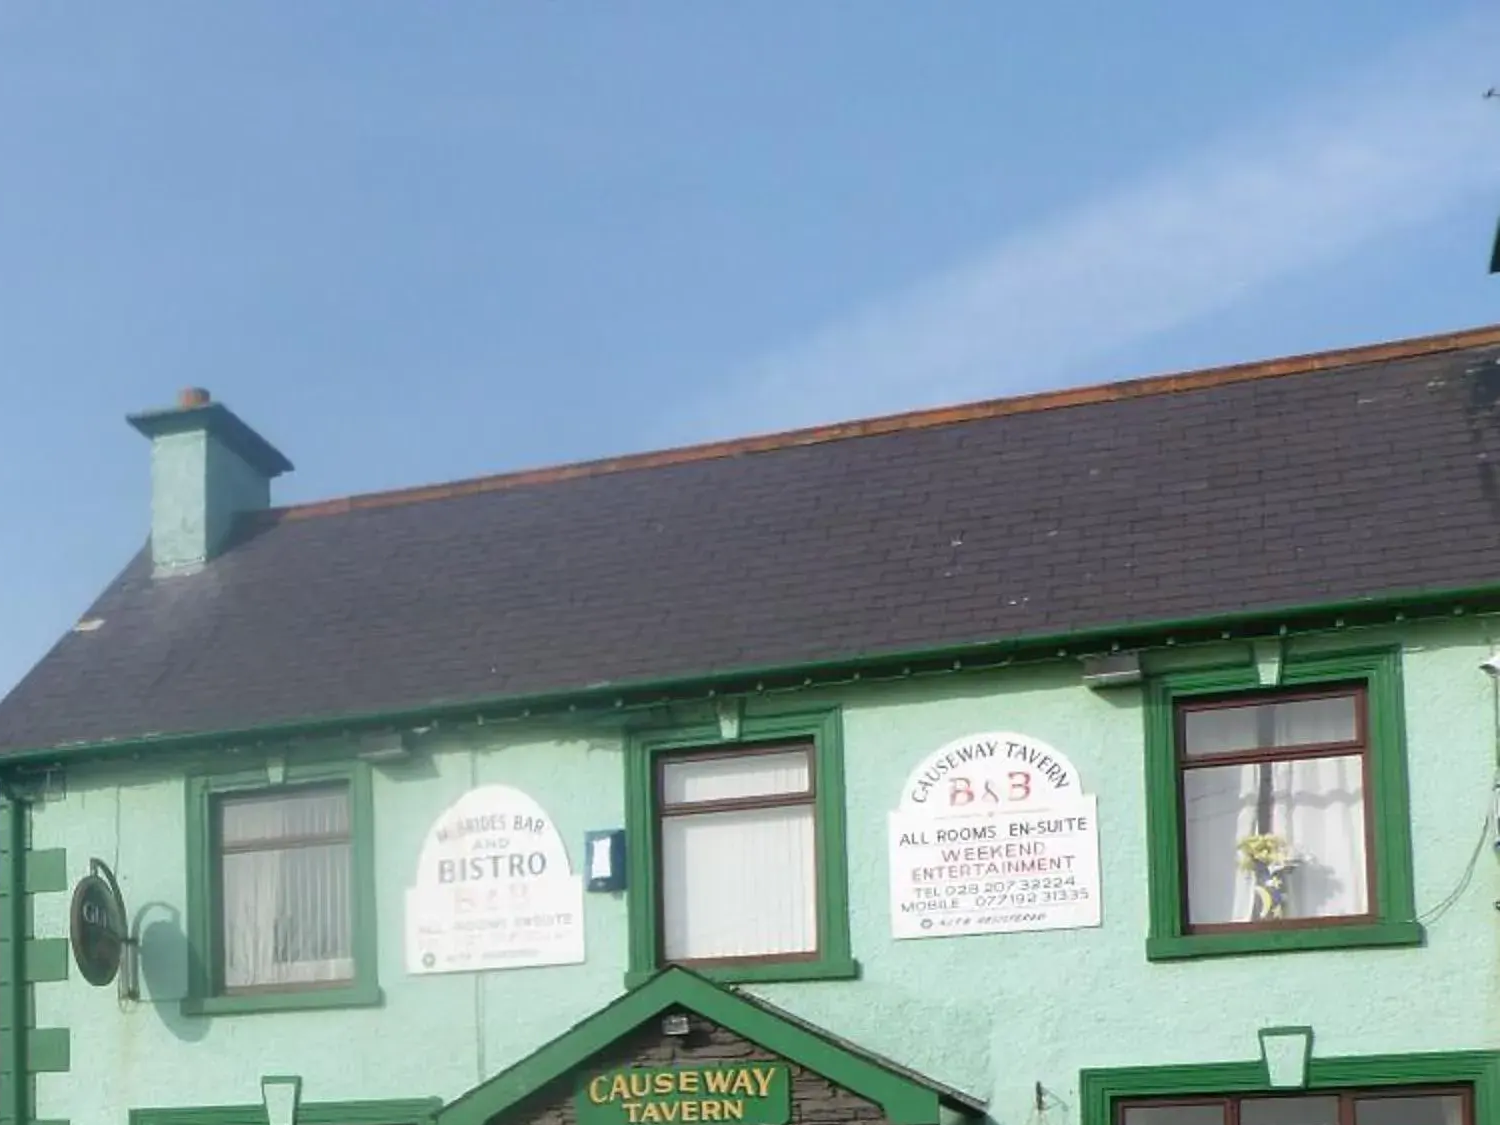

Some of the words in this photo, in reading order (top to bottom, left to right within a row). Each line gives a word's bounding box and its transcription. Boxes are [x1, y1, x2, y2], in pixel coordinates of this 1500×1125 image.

[912, 740, 998, 803] CAUSEWAY
[1006, 741, 1070, 790] TAVERN
[949, 777, 975, 806] B
[1008, 771, 1031, 801] B
[513, 815, 545, 835] BAR
[899, 833, 929, 847] ALL
[936, 825, 997, 843] ROOMS
[1009, 817, 1088, 837] EN-SUITE
[941, 841, 1045, 863] WEEKEND
[438, 852, 547, 884] BISTRO
[912, 856, 1075, 881] ENTERTAINMENT
[901, 899, 960, 913] MOBILE
[915, 887, 940, 900] TEL
[589, 1067, 776, 1104] CAUSEWAY
[622, 1100, 745, 1123] TAVERN
